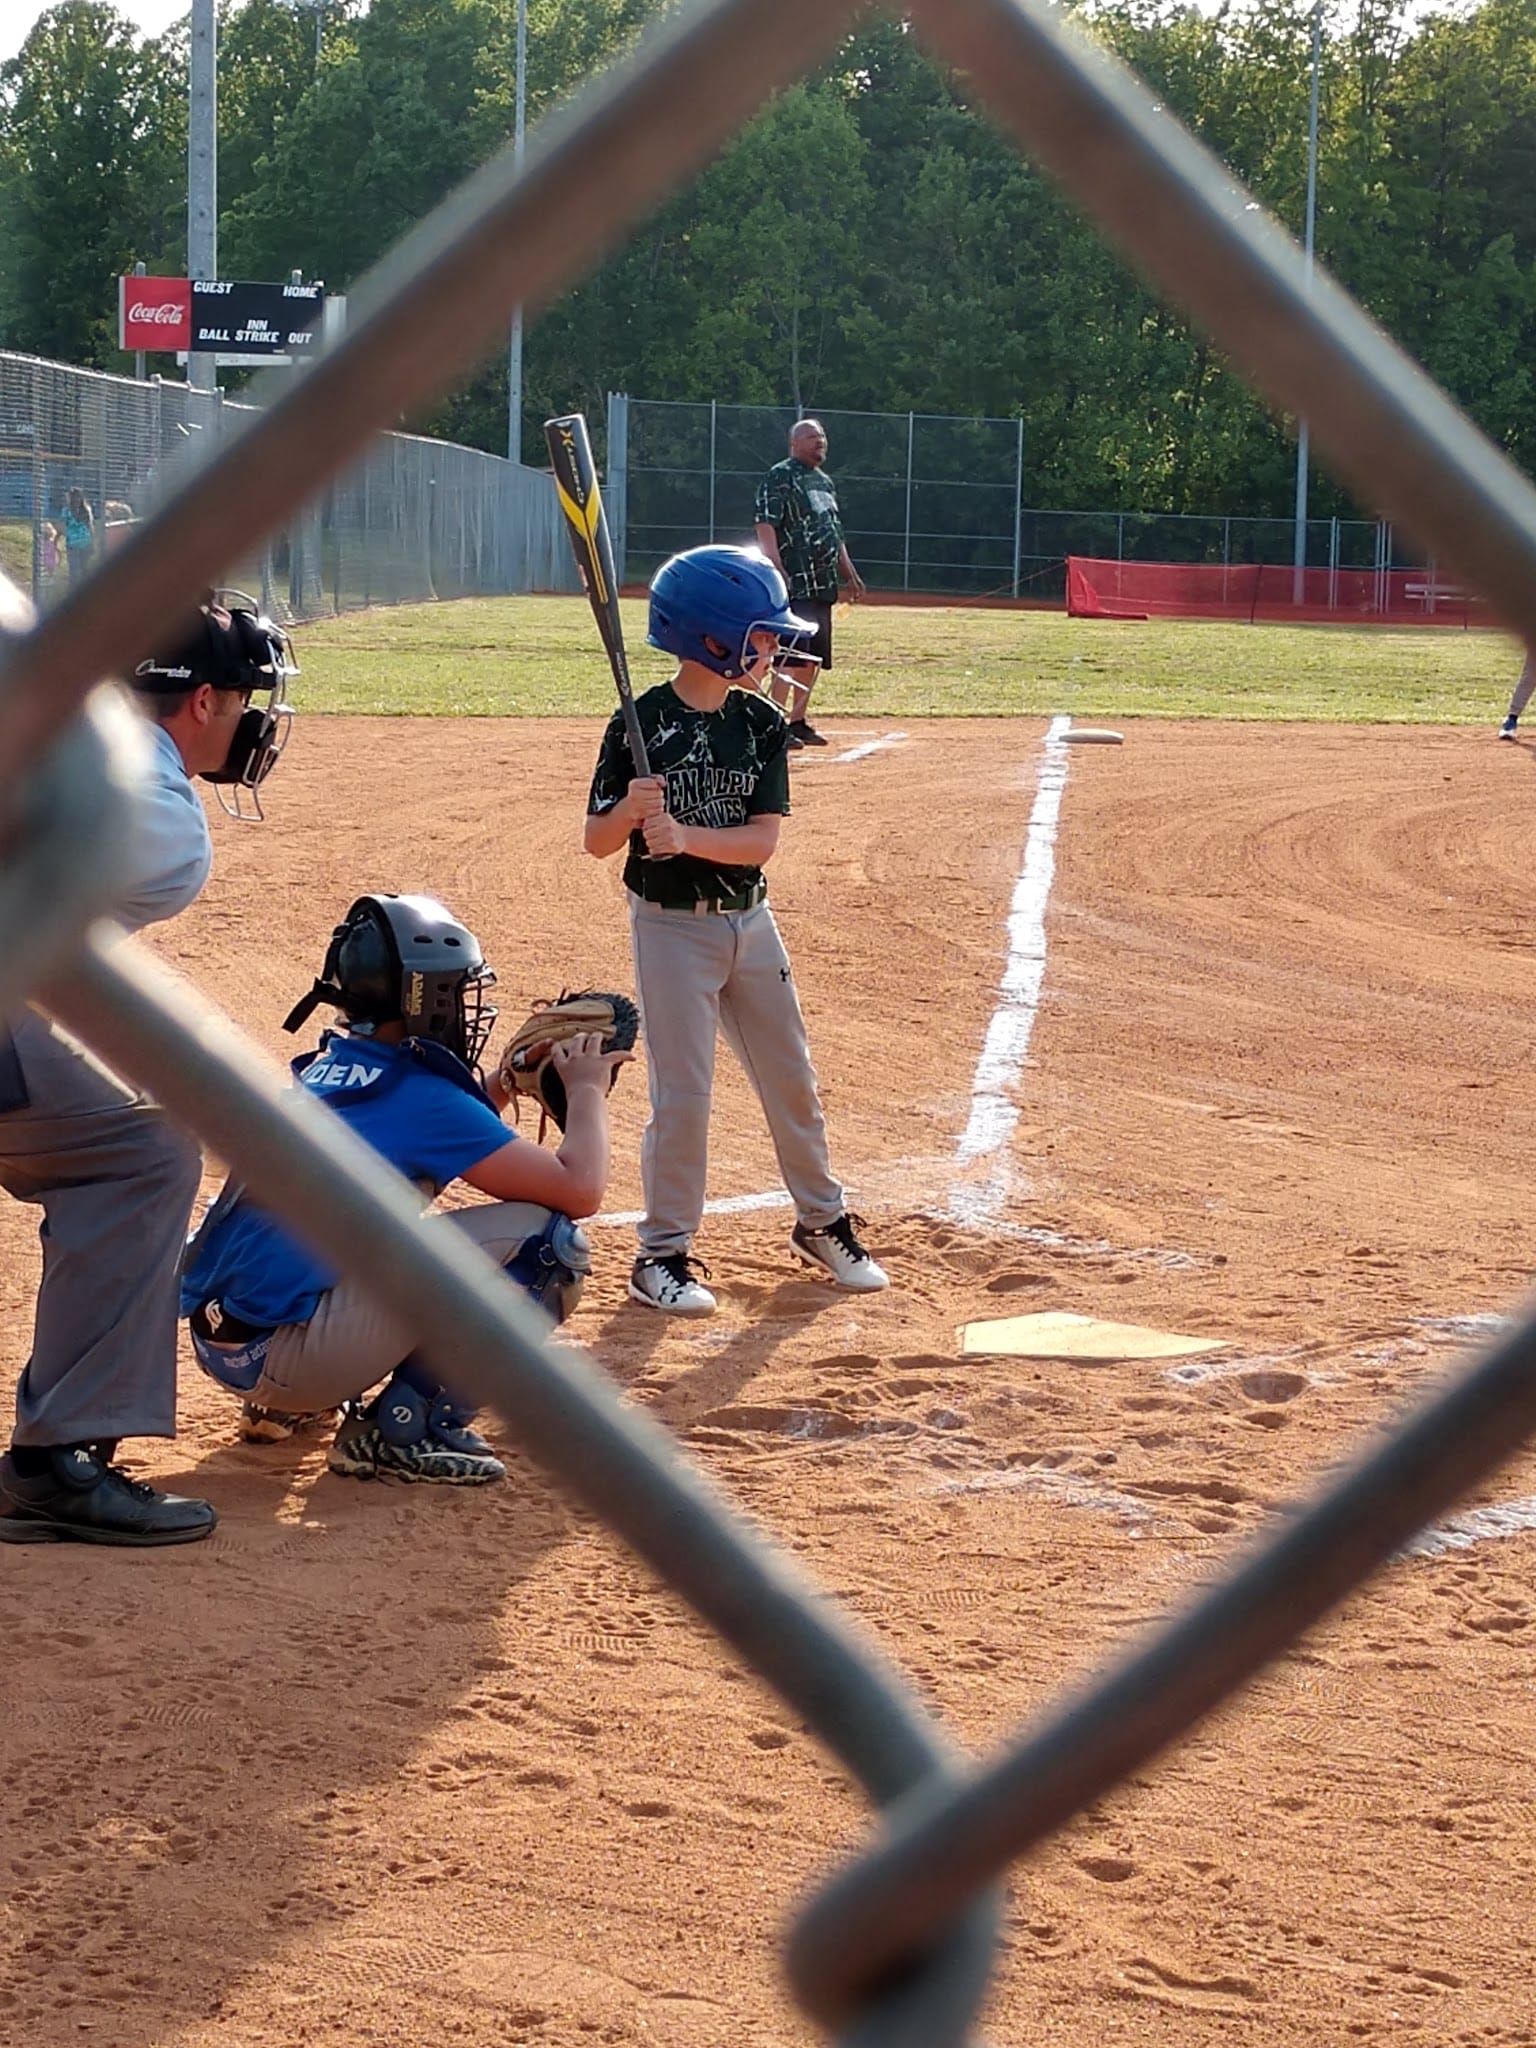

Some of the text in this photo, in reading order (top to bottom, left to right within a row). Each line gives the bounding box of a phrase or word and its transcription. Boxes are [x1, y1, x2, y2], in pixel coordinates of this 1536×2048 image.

[193, 281, 318, 298] GUEST HOME
[246, 319, 268, 331] INN
[199, 329, 312, 344] BALL STRIKE OUT
[305, 1063, 384, 1087] DEN
